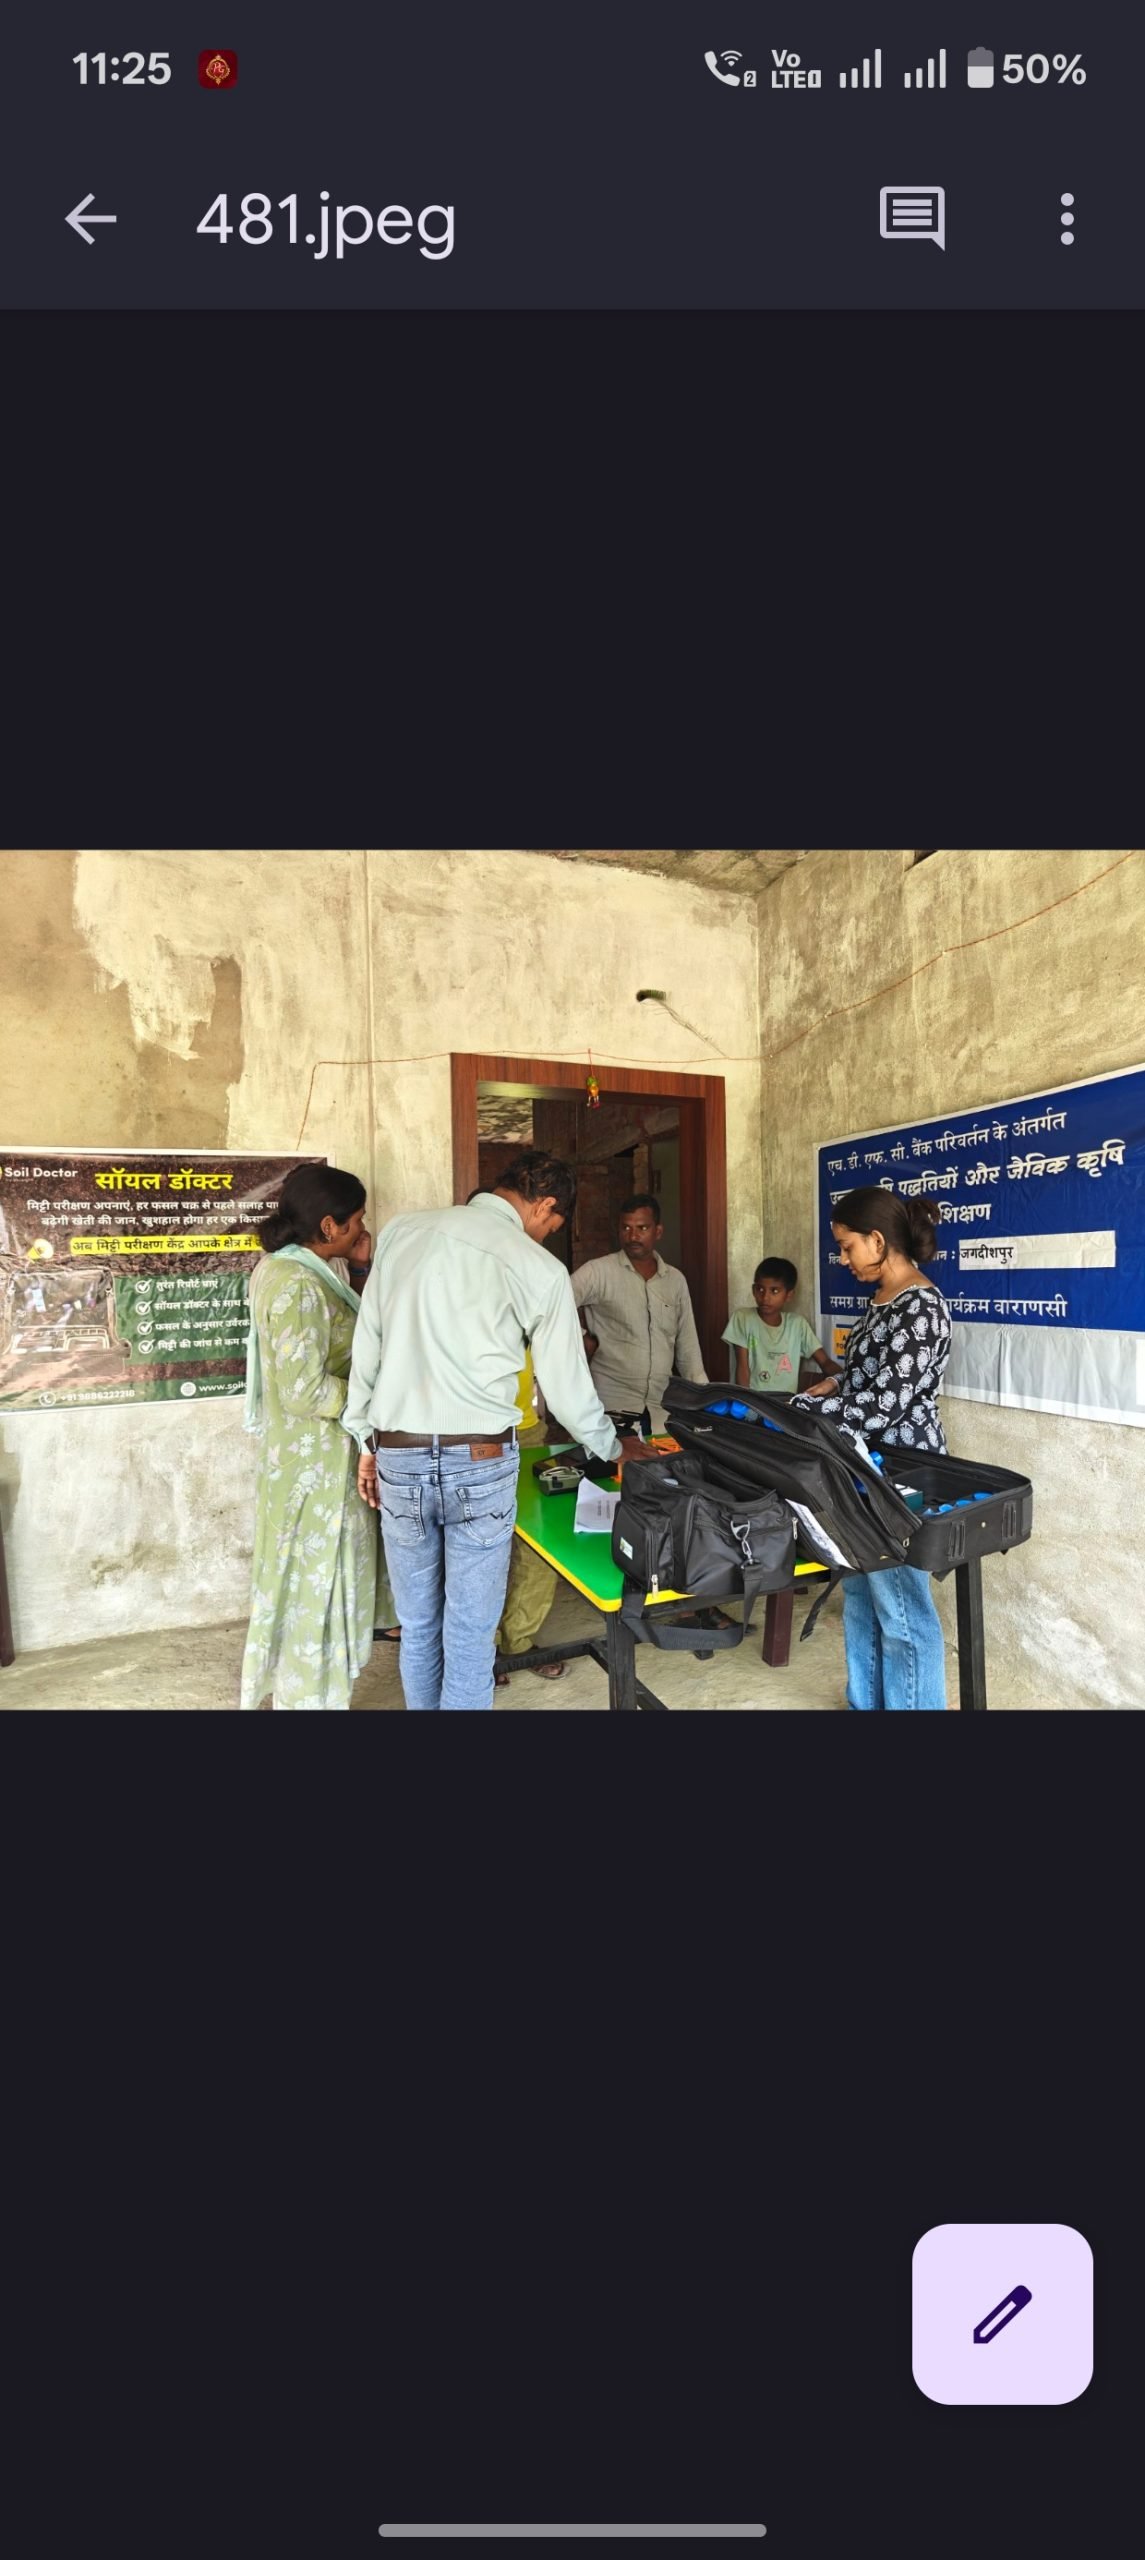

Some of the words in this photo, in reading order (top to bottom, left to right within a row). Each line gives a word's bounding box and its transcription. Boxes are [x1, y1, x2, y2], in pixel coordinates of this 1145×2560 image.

[72, 51, 172, 86] 11:25
[771, 49, 800, 68] Vo
[1002, 53, 1087, 86] 50%
[196, 191, 456, 260] 481.jpeg
[911, 1138, 932, 1157] बैंक
[935, 1124, 990, 1152] परिवर्तन
[992, 1121, 1008, 1141] के
[1011, 1107, 1067, 1137] अंतर्गत
[4, 1166, 29, 1178] Soil
[33, 1167, 79, 1178] Doctor
[898, 1166, 959, 1197] पद्धतियों
[965, 1162, 1000, 1186] और
[1006, 1152, 1070, 1180] जैविक
[1076, 1138, 1127, 1178] कृषि
[95, 1168, 162, 1190] सॉयल
[168, 1168, 234, 1190] डॉक्टर
[51, 1199, 90, 1211] परीक्षण
[136, 1201, 149, 1210] हर
[151, 1201, 178, 1212] फसल
[201, 1199, 211, 1209] से
[213, 1199, 235, 1210] पहले
[238, 1201, 264, 1211] सलाह
[72, 1214, 95, 1226] खेती
[97, 1214, 112, 1225] की
[142, 1215, 180, 1227] खुशहाल
[183, 1213, 203, 1225] होगा
[206, 1215, 218, 1225] हर
[220, 1215, 237, 1225] एक
[73, 1241, 92, 1251] अब
[124, 1239, 163, 1250] परीक्षण
[188, 1237, 221, 1249] आपके
[960, 1243, 1014, 1264] जगदीशपुर
[830, 1296, 854, 1309] समग्र
[993, 1293, 1068, 1318] वाराणसी
